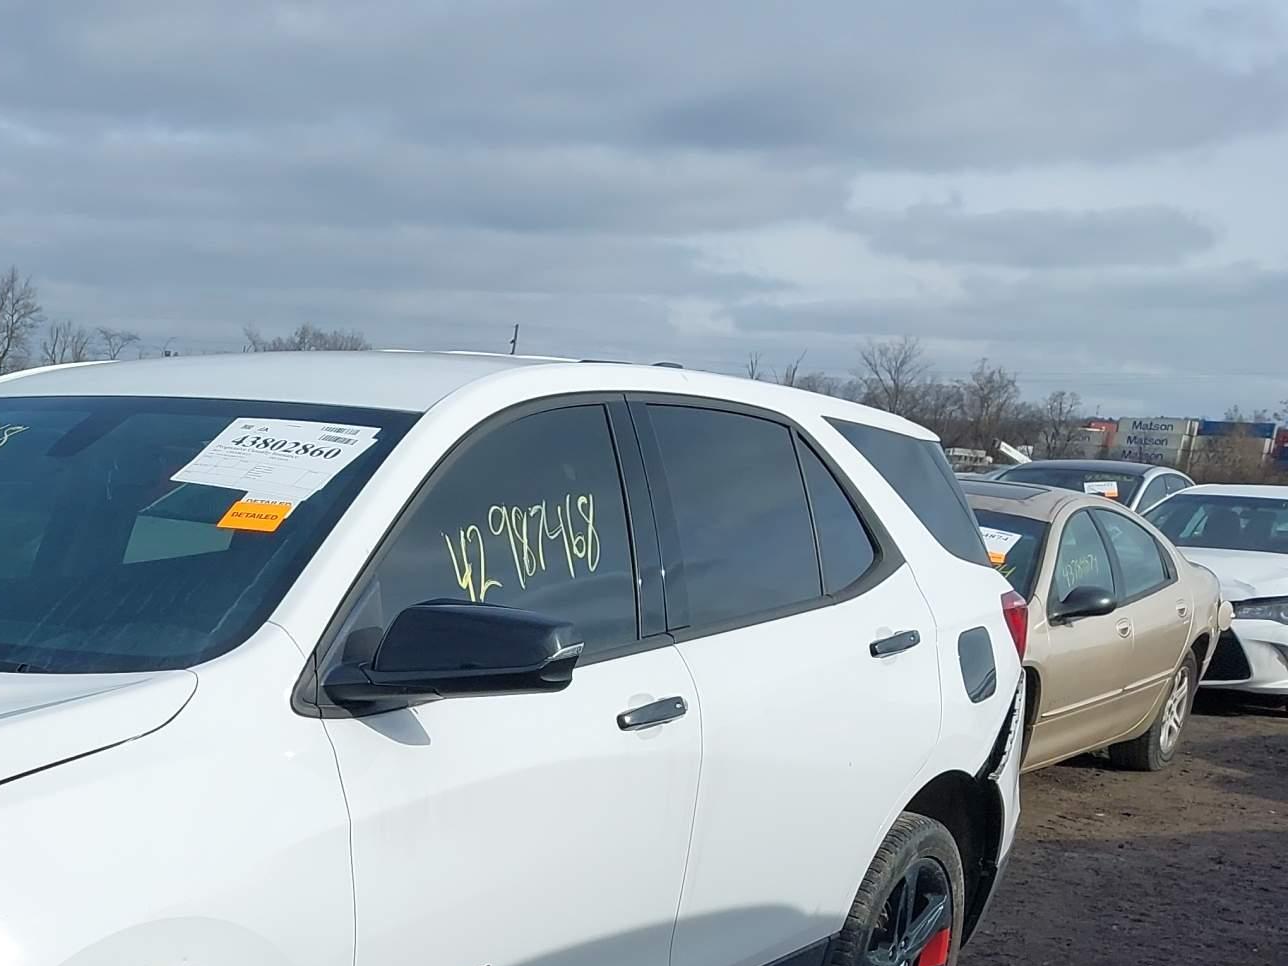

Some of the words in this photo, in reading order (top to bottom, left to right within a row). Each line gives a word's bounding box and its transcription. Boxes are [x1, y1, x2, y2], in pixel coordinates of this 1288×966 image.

[1131, 420, 1174, 432] Matson
[231, 433, 342, 461] 43802860
[1126, 435, 1169, 447] Matson
[231, 511, 279, 521] DETAILED
[440, 493, 601, 603] 42987468
